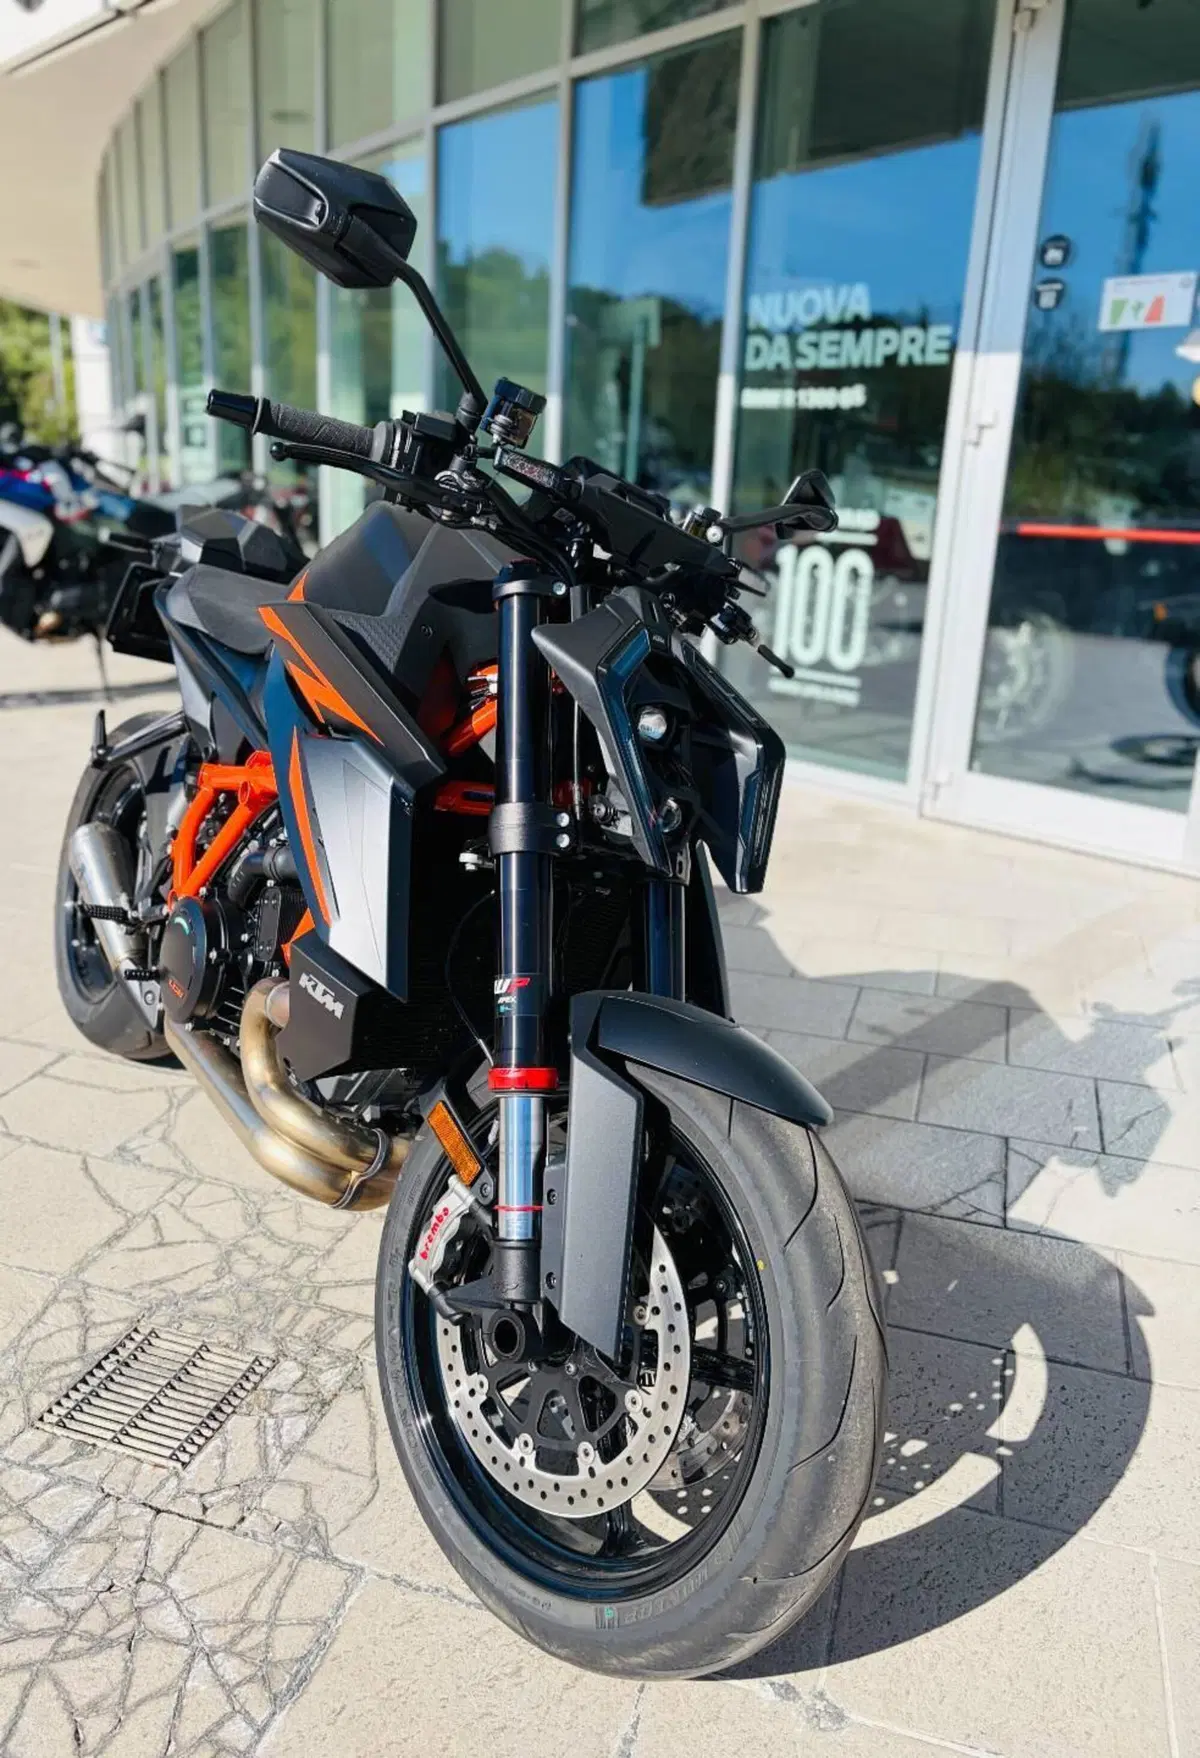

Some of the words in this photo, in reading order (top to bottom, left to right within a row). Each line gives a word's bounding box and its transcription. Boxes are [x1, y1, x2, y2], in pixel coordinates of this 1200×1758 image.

[749, 281, 870, 329] NUOVA
[773, 544, 875, 670] 100
[298, 972, 345, 1020] KTM
[420, 1206, 450, 1261] brembo
